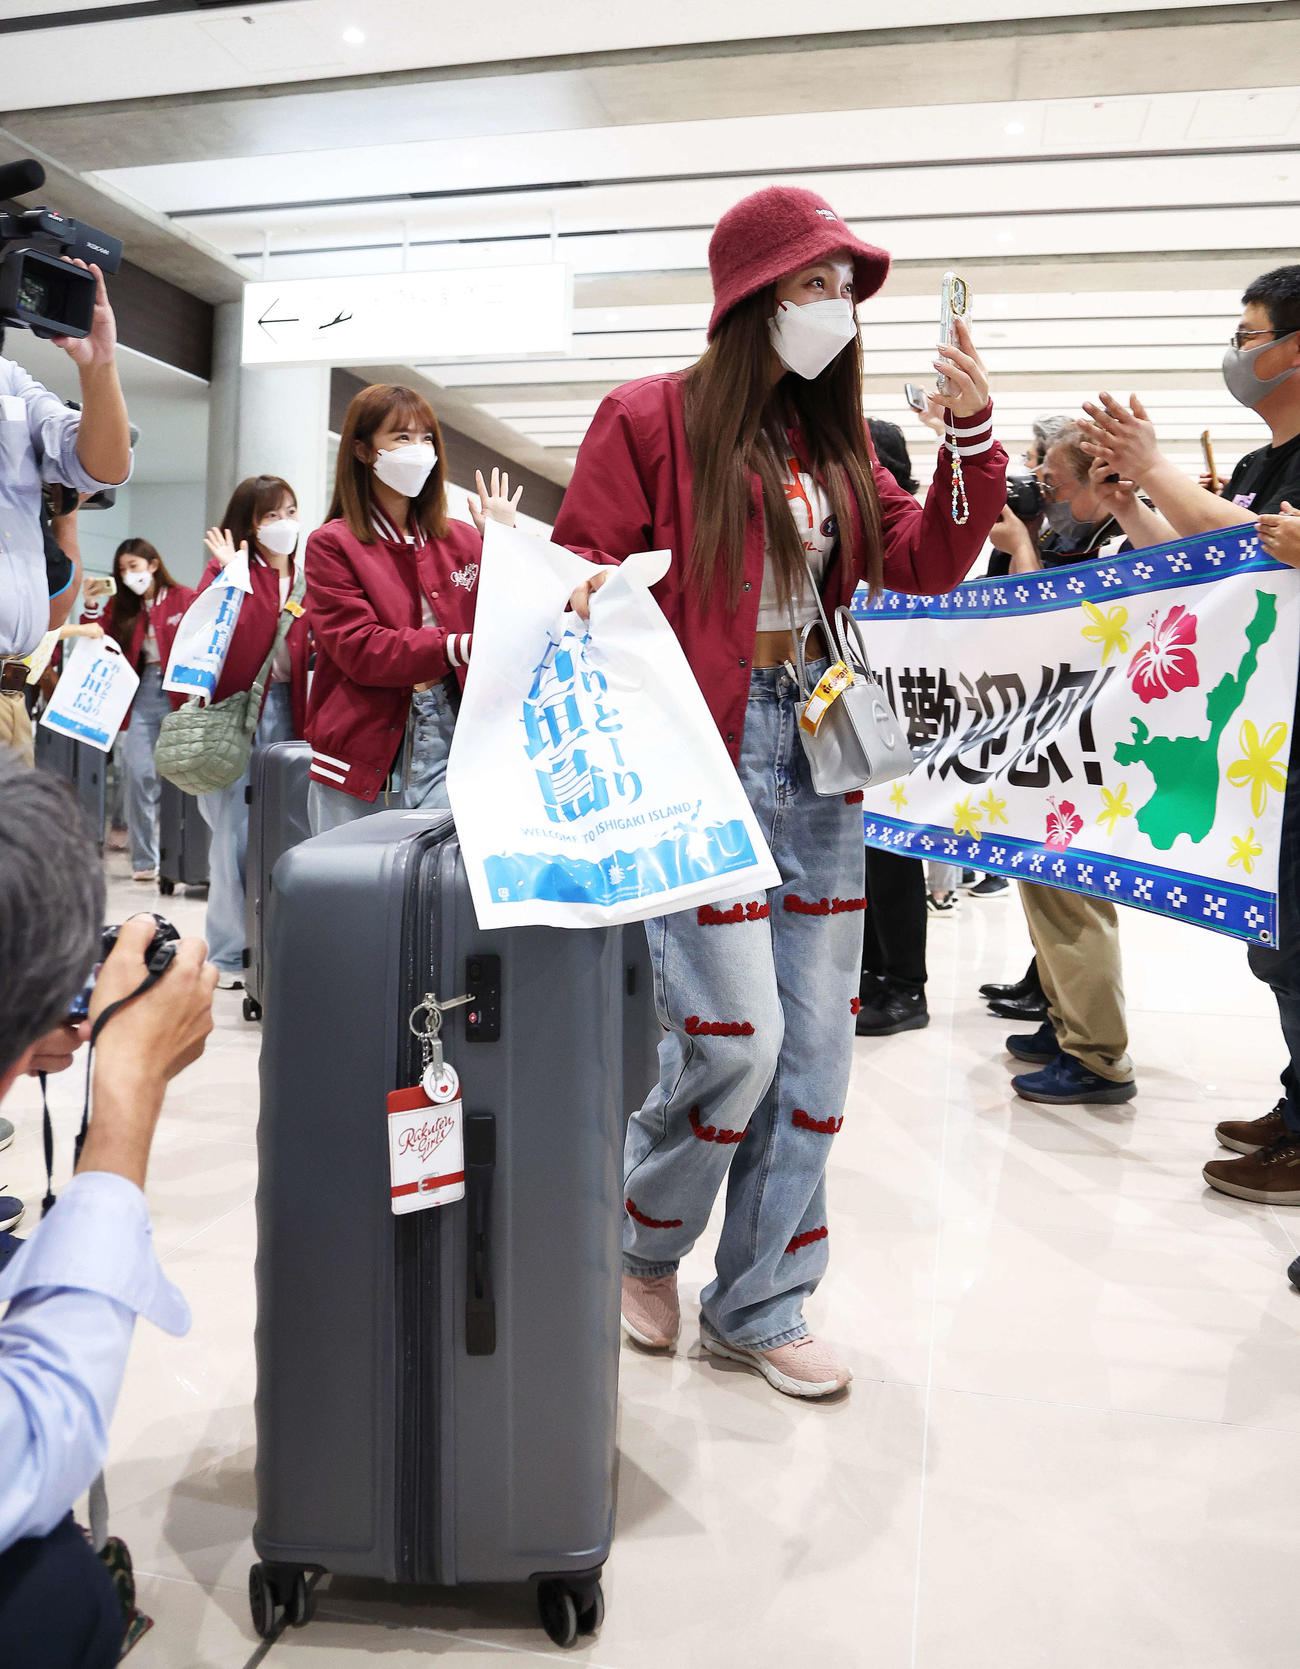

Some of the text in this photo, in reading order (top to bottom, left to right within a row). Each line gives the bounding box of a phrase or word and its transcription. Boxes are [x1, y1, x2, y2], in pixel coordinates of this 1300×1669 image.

[595, 808, 646, 836] ISHIGAKI
[648, 802, 692, 822] ISLAND
[398, 1115, 454, 1156] Rakuten
